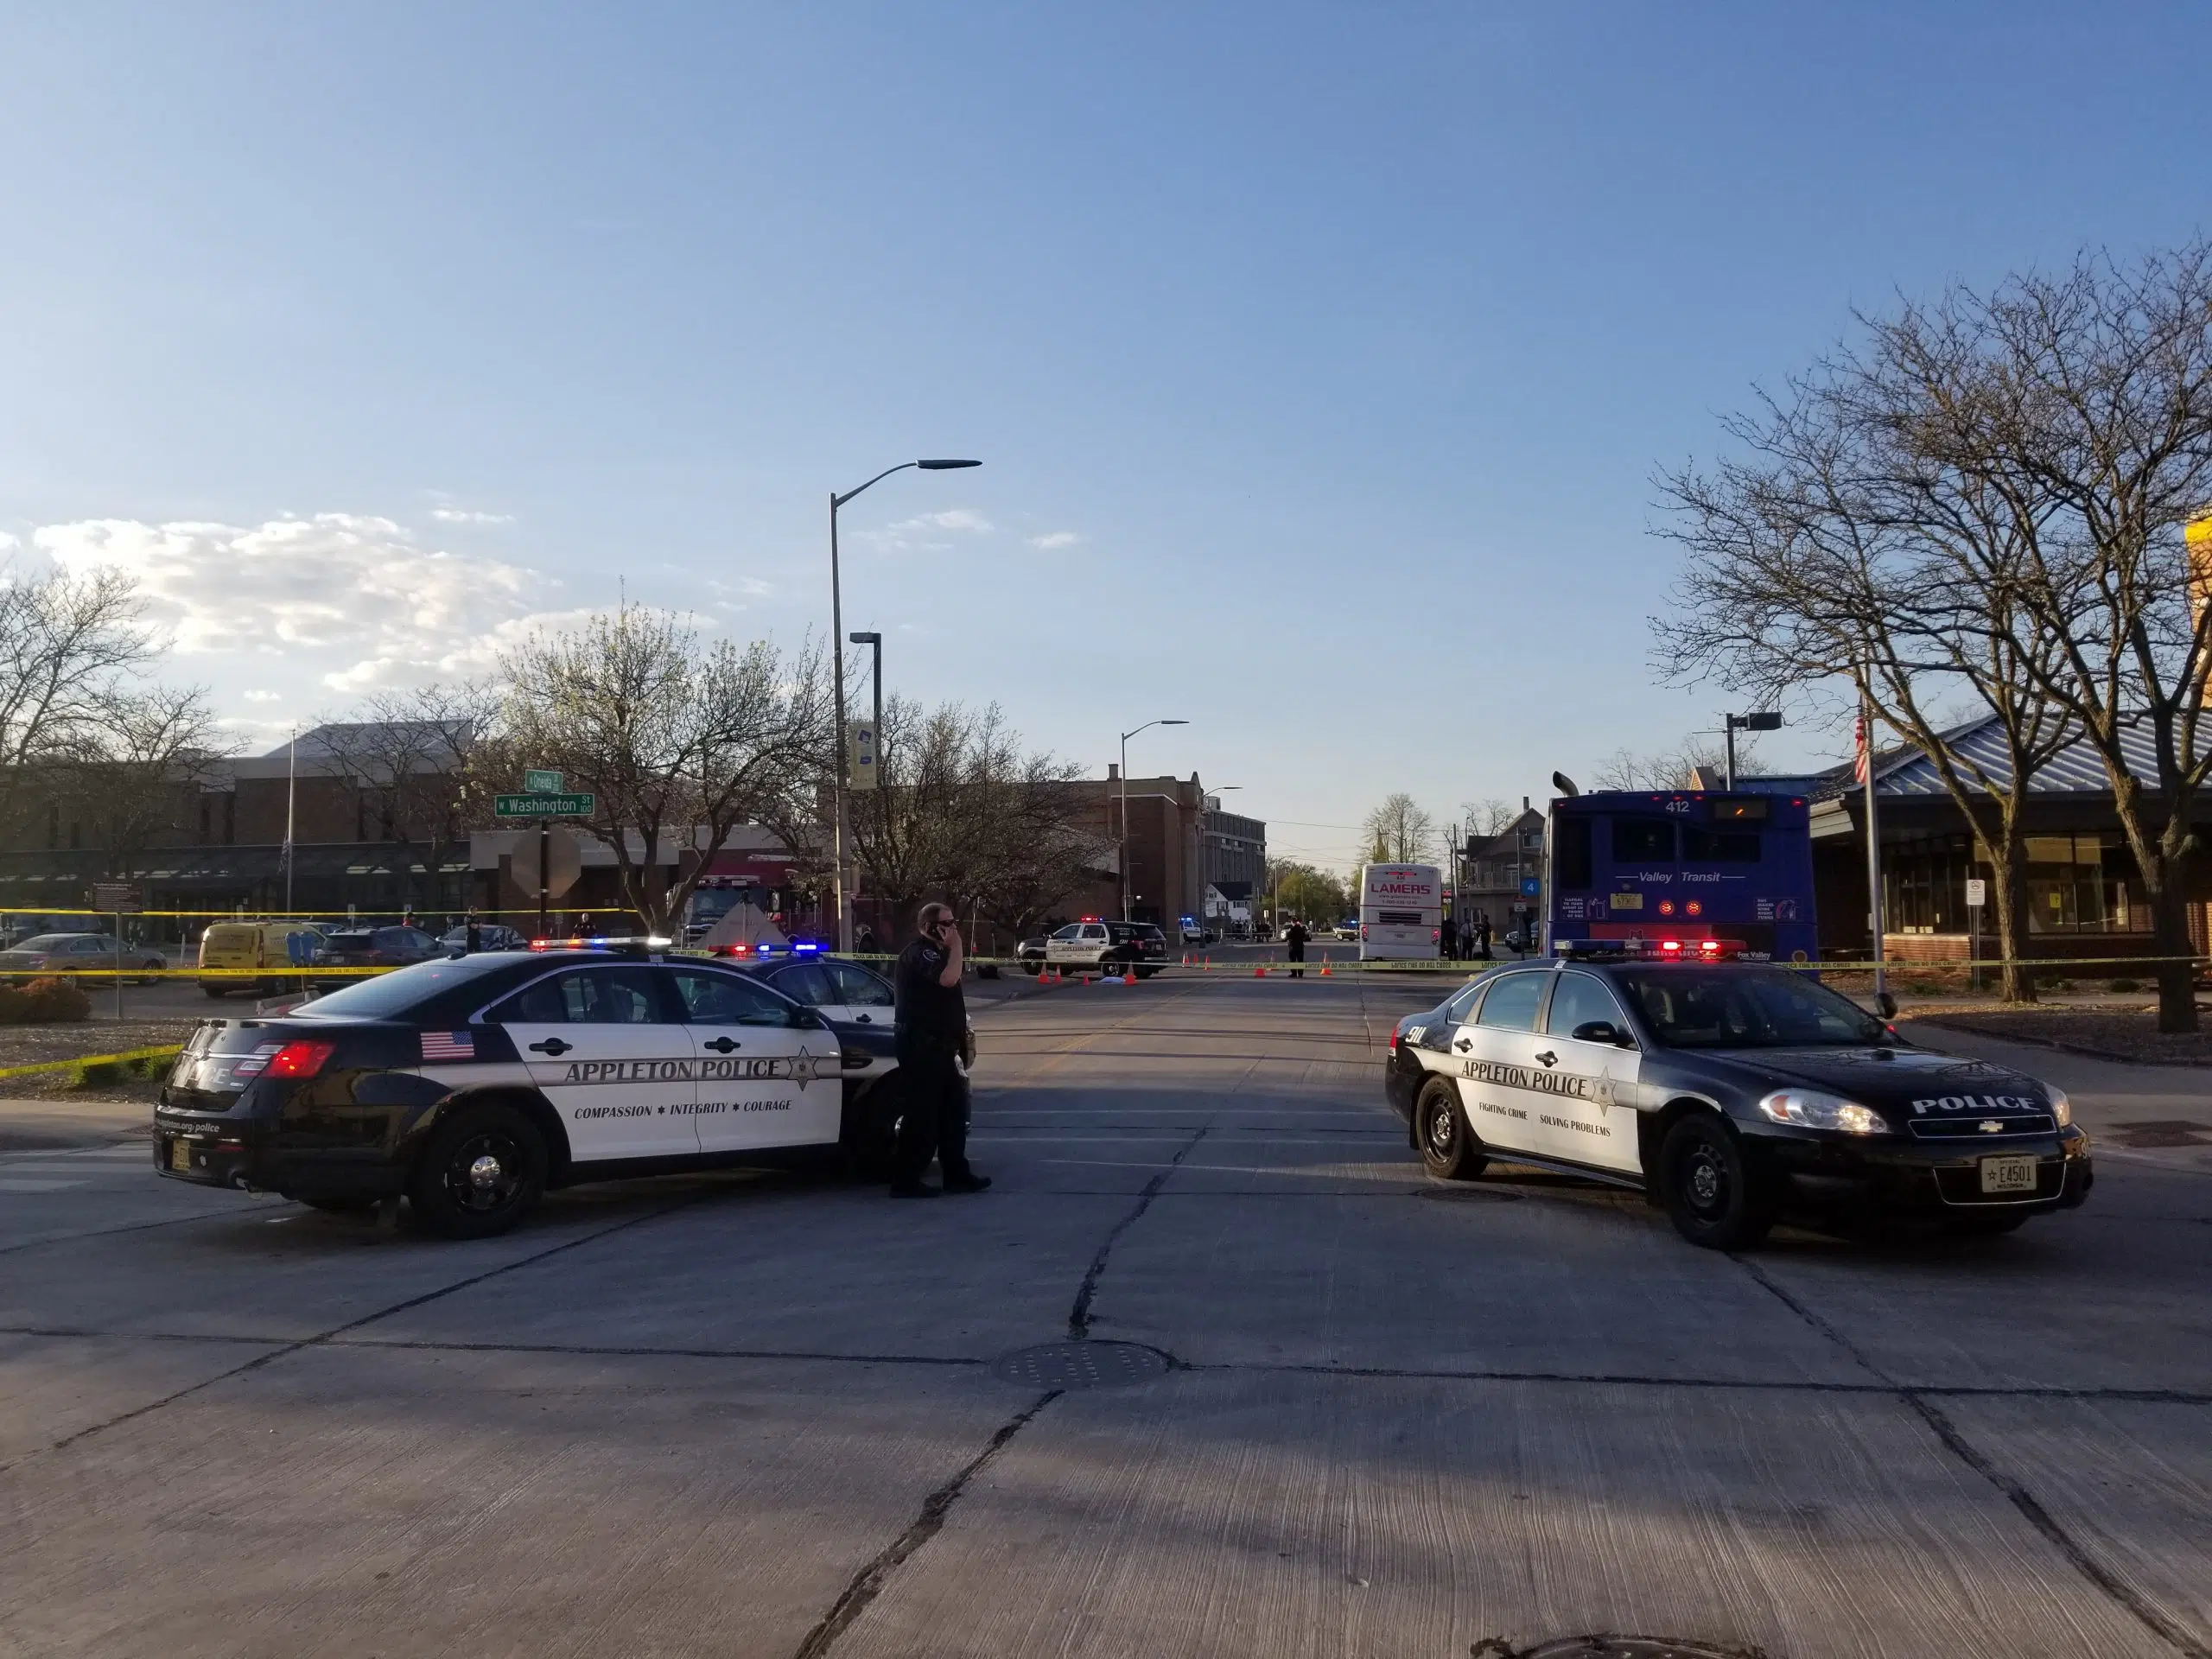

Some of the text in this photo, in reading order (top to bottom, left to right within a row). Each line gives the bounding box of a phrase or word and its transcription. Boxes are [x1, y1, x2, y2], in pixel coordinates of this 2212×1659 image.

[533, 774, 552, 789] Oneida
[499, 795, 590, 813] W Washington St
[580, 804, 592, 813] 100
[1666, 801, 1690, 812] 412
[1639, 872, 1721, 883] Valley Transit
[1370, 883, 1431, 894] LAMERS
[1527, 882, 1535, 893] 4
[1750, 950, 1771, 961] Valley
[1406, 1026, 1427, 1041] 911
[565, 1061, 693, 1082] APPLETON
[702, 1059, 780, 1079] POLICE
[1461, 1060, 1587, 1097] APPLETON POLICE
[574, 1099, 792, 1120] COMPASSION INTEGRITY COURAGE
[1478, 1102, 1529, 1121] FIGHTING CRIME
[1912, 1095, 2040, 1114] POLICE
[157, 1118, 220, 1134] .appleton.org/police
[1540, 1115, 1611, 1137] SOLVING PROBLEMS
[1999, 1165, 2031, 1183] E4501
